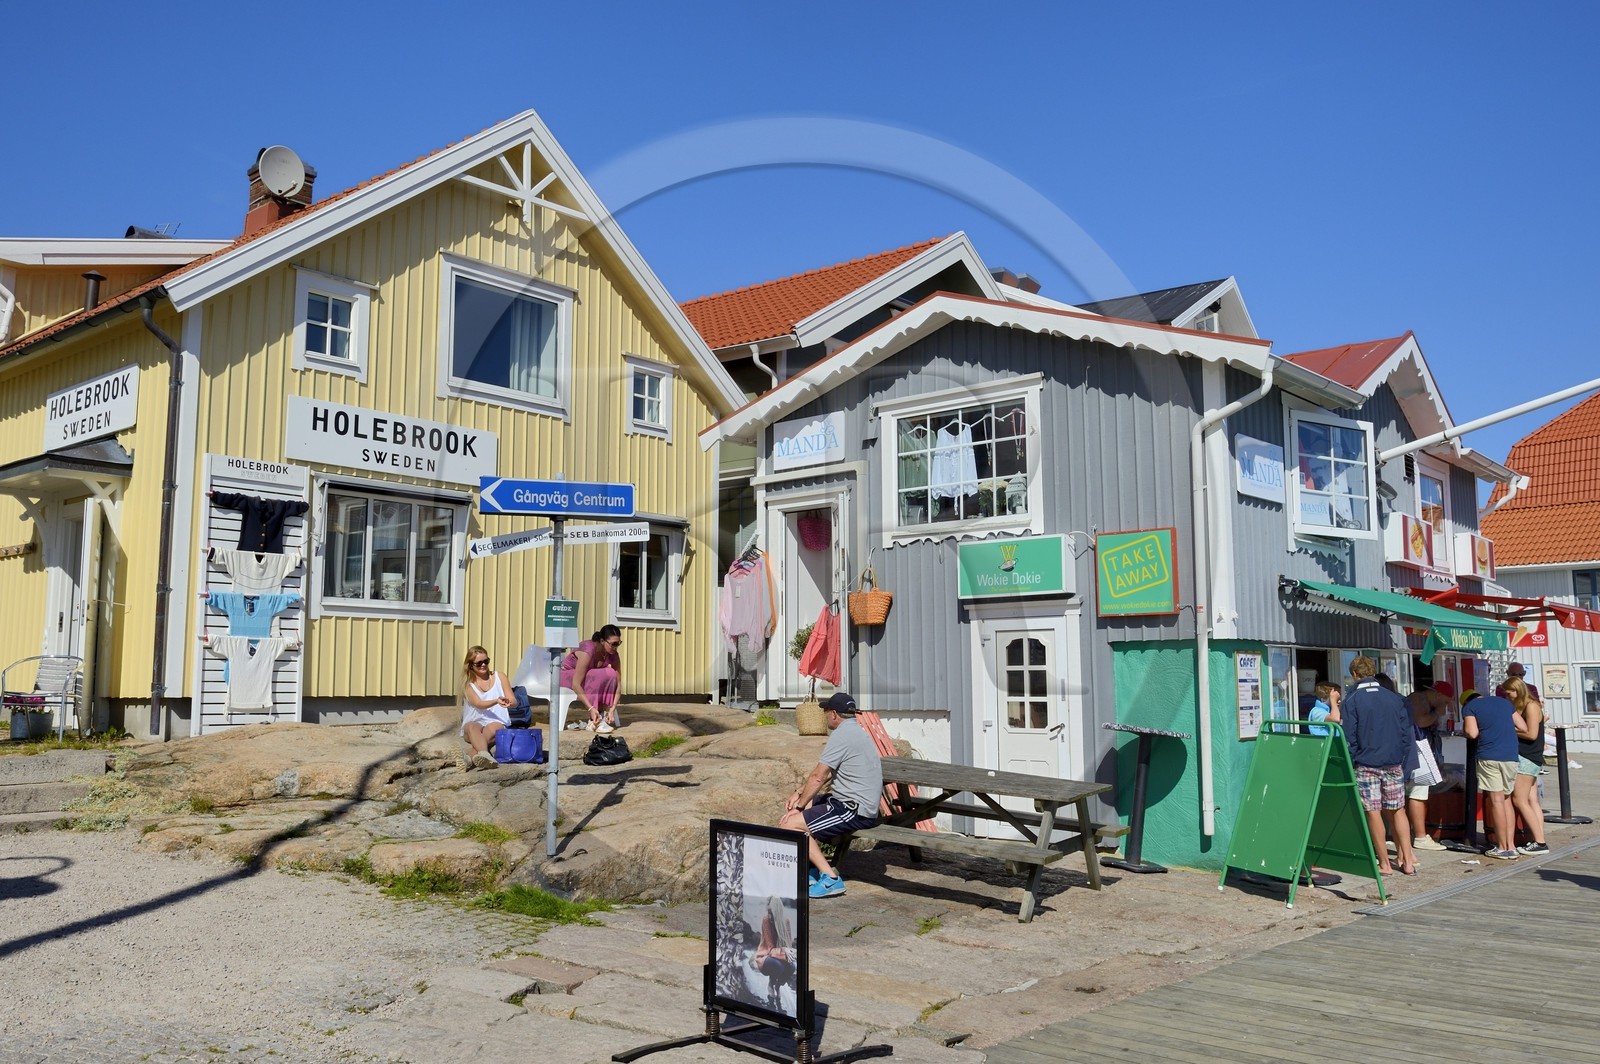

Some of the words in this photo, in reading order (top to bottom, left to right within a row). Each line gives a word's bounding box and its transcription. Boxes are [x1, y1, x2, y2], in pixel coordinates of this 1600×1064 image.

[49, 372, 131, 421] HOLEBROOK
[62, 410, 112, 441] SWEDEN
[311, 406, 478, 458] HOLEBROOK
[777, 431, 839, 457] MANDA
[227, 458, 289, 475] HOLEBROOK
[361, 448, 436, 473] SWEDEN
[1241, 456, 1283, 488] MANDA
[513, 487, 569, 508] Gångväg
[573, 490, 626, 508] Centrum
[478, 536, 531, 552] SEGELMAKERI
[534, 534, 549, 543] 50m
[591, 529, 627, 538] Bankomat
[628, 528, 648, 536] 200m
[1108, 544, 1156, 571] TAKE
[976, 573, 1009, 587] Wokie
[1012, 571, 1042, 585] Dokie
[1115, 561, 1161, 591] AWAY
[761, 851, 797, 863] HOLEBROOK
